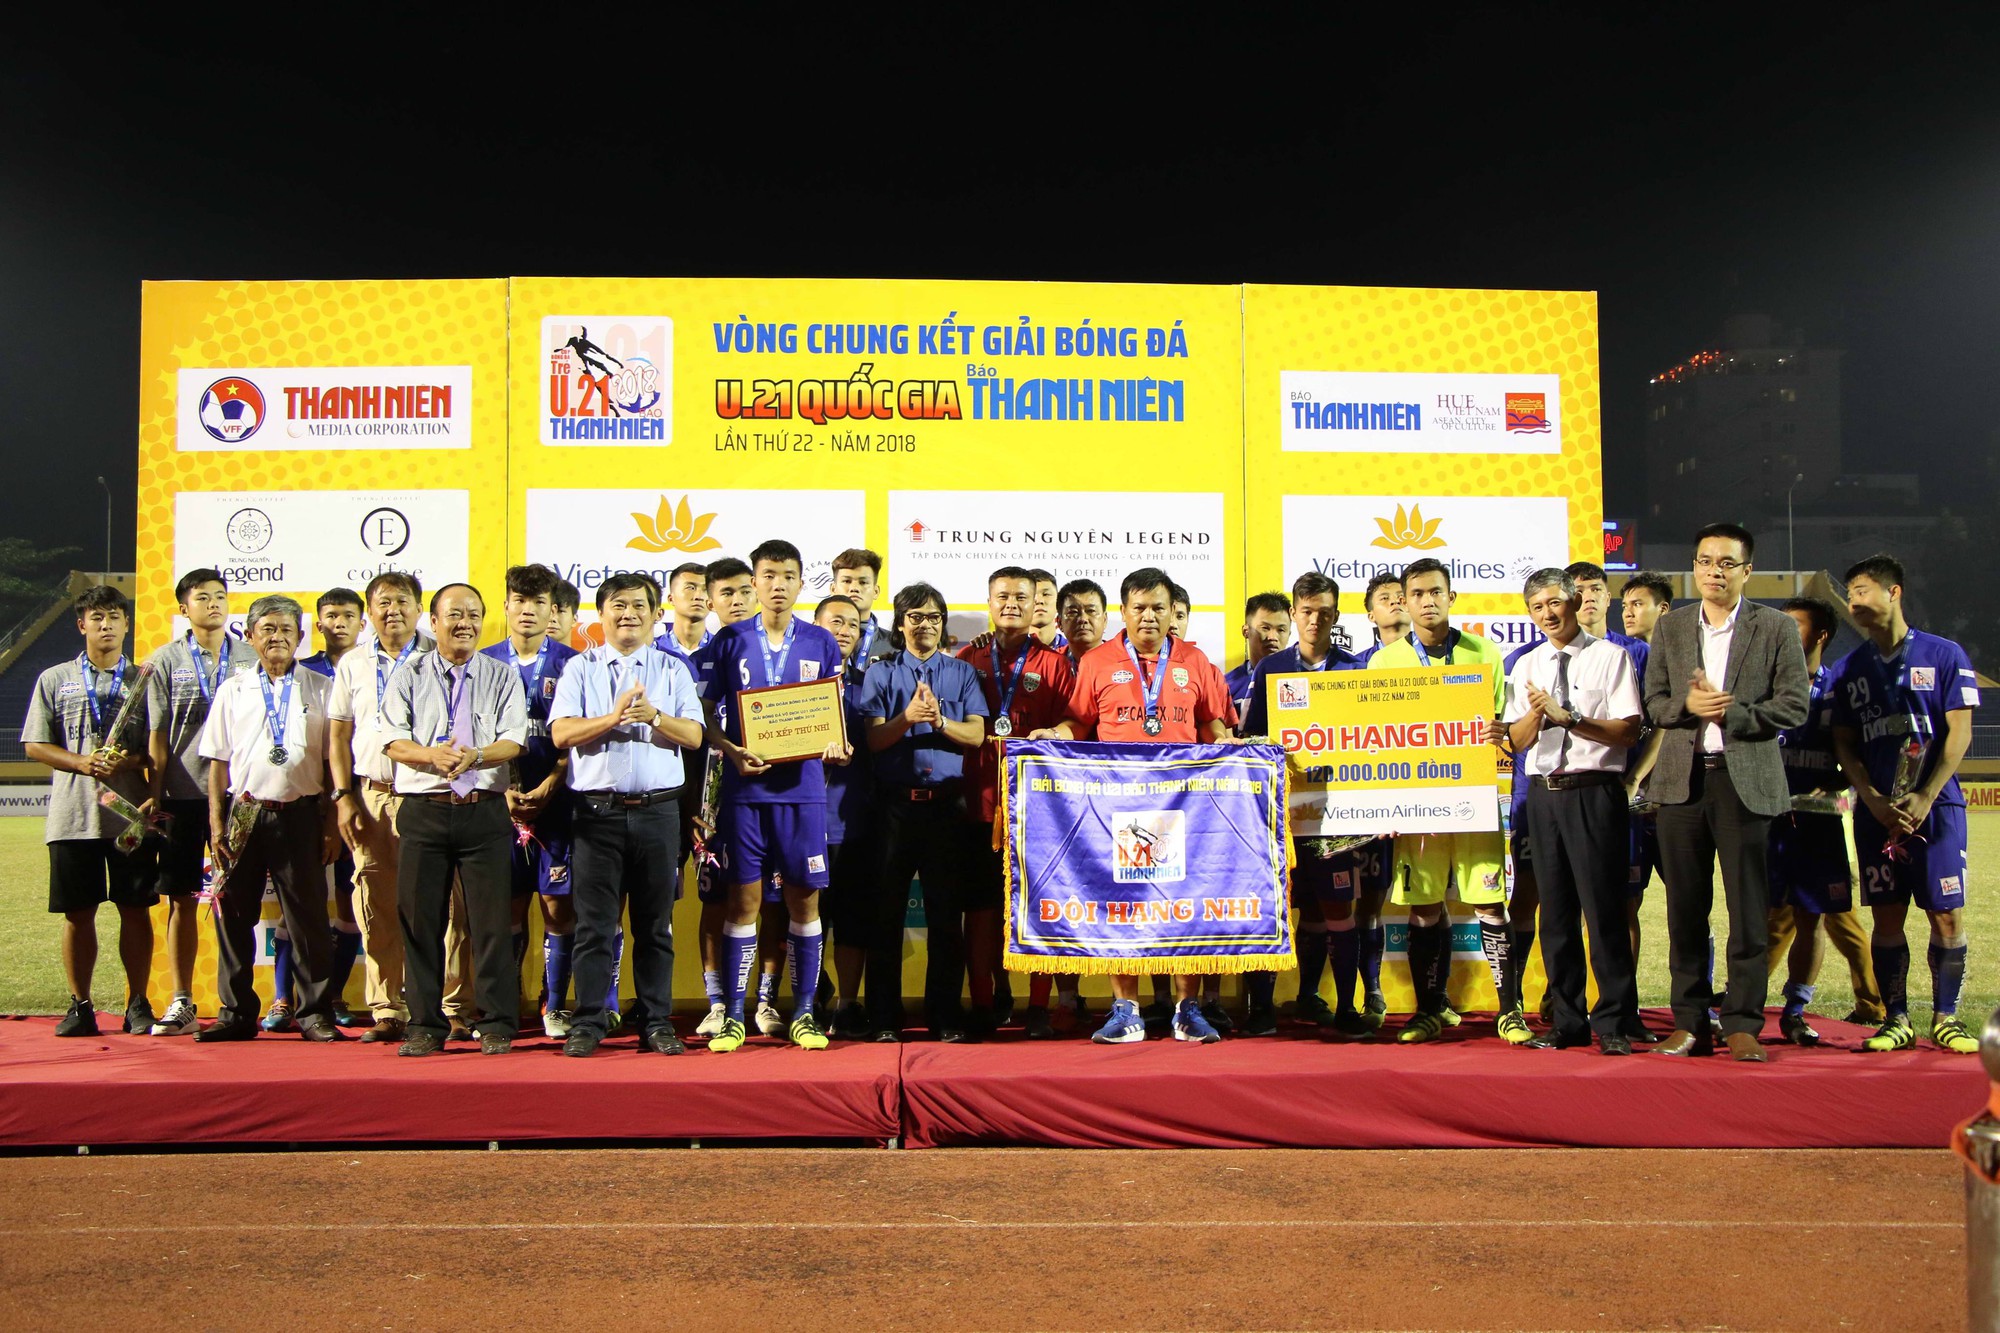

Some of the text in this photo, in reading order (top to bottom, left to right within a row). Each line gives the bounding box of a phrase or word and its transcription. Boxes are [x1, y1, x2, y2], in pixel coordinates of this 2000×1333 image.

[713, 311, 1189, 358] VÒNG CHUNG KẾT GIẢI BÓNG ĐÁ
[966, 363, 998, 378] Báo
[550, 374, 610, 417] U.21
[715, 362, 963, 425] U.21 QUỐC GIA
[1437, 394, 1475, 409] HUE
[1475, 406, 1501, 416] NAM
[223, 424, 242, 434] VFF
[308, 422, 451, 436] MEDIA CORPORATION
[715, 425, 747, 452] LẦN
[753, 429, 789, 452] THỨ
[793, 433, 813, 452] 22
[831, 430, 870, 452] NĂM
[876, 434, 916, 453] 2018
[378, 518, 394, 546] E
[936, 528, 1211, 546] TRUNG NGUYÊN LEGEND
[553, 563, 676, 589] Vietm
[1065, 568, 1119, 577] COFFEE!
[1846, 676, 1870, 710] 29
[1173, 706, 1188, 724] IDC
[1281, 716, 1487, 756] ĐỘI HẠNG NHÌ
[1305, 758, 1462, 784] 120.000.000 đồng
[1324, 806, 1390, 820] Vietnam
[1391, 803, 1451, 818] Airlines
[1403, 864, 1411, 891] 1
[1865, 863, 1895, 893] 29
[1039, 891, 1262, 930] ĐỘI HẠNG NHÌ
